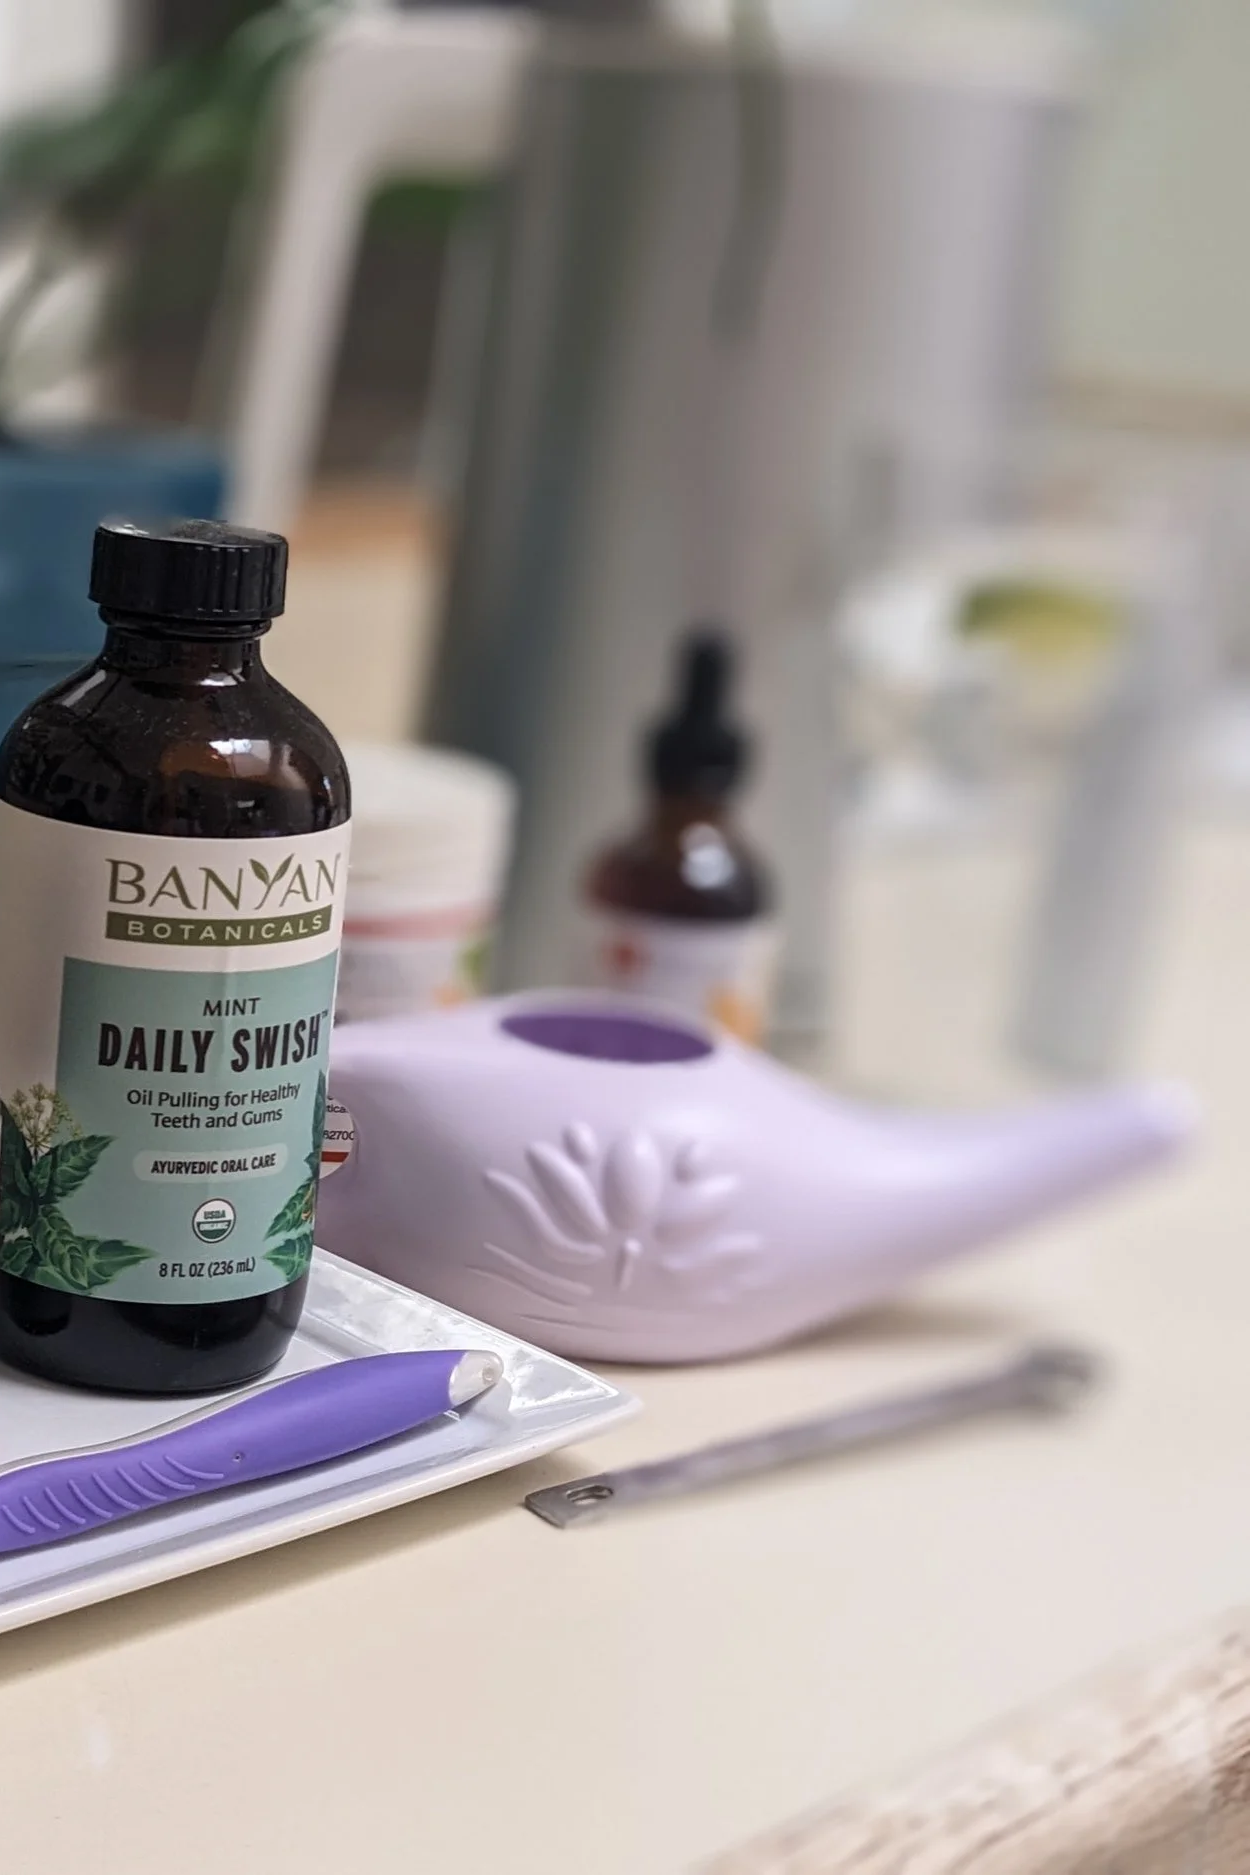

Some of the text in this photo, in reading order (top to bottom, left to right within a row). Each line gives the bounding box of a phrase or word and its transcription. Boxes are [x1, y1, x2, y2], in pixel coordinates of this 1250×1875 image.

[105, 852, 342, 911] BANYAN
[128, 915, 325, 941] BOTANICALS
[202, 996, 262, 1017] MINT
[98, 1013, 321, 1074] DAILY SWISH
[126, 1083, 301, 1110] Oil Pulling for Healthy
[151, 1108, 283, 1128] Teeth and Gums
[151, 1153, 277, 1175] AYURVEDIC ORAL CARE
[159, 1257, 256, 1278] 8 FL OZ (236 mL)
